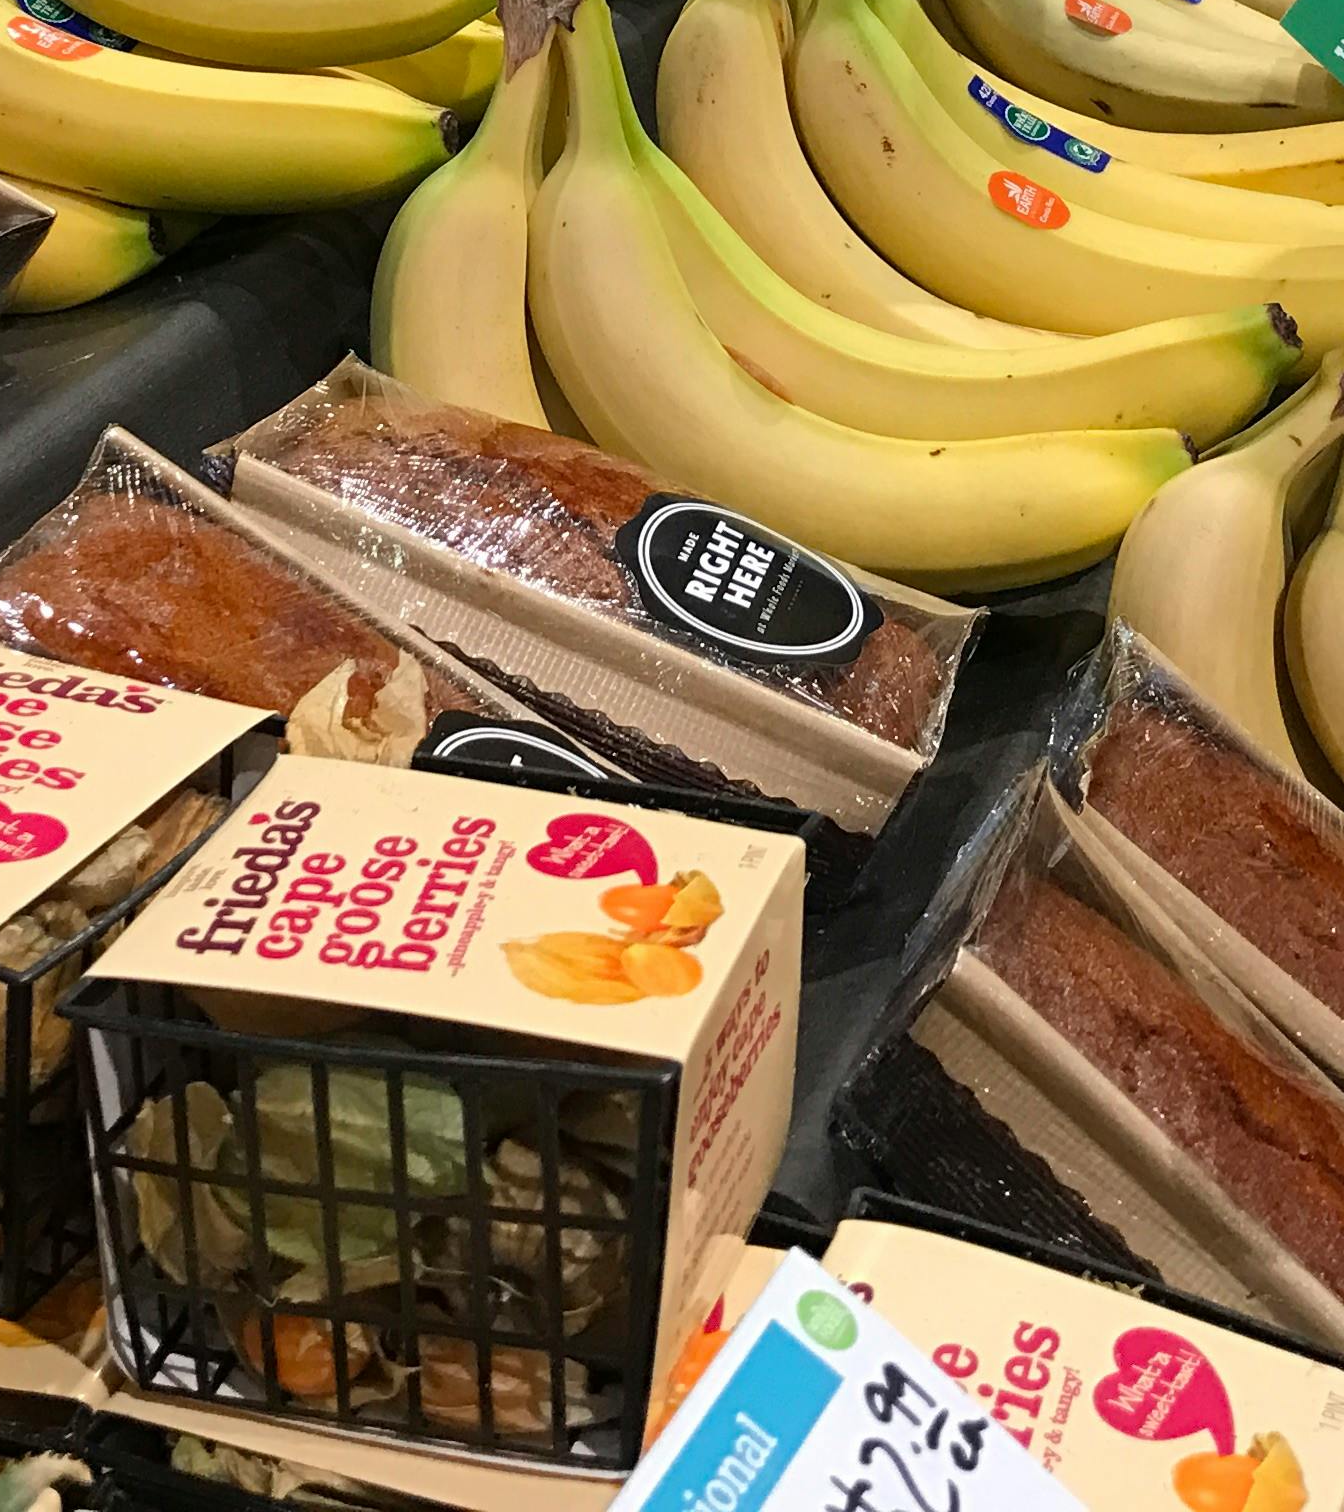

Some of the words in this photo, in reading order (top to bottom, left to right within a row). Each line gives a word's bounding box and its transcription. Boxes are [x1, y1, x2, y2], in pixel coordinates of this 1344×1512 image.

[1016, 184, 1038, 216] EARTH
[676, 531, 701, 564] MADE
[683, 519, 745, 604] RIGHT
[722, 540, 777, 610] HERE
[759, 596, 781, 624] Whole
[21, 829, 36, 845] a
[255, 852, 347, 960] cape
[318, 835, 419, 970] goose
[374, 815, 497, 973] berries
[1106, 1362, 1165, 1414] What
